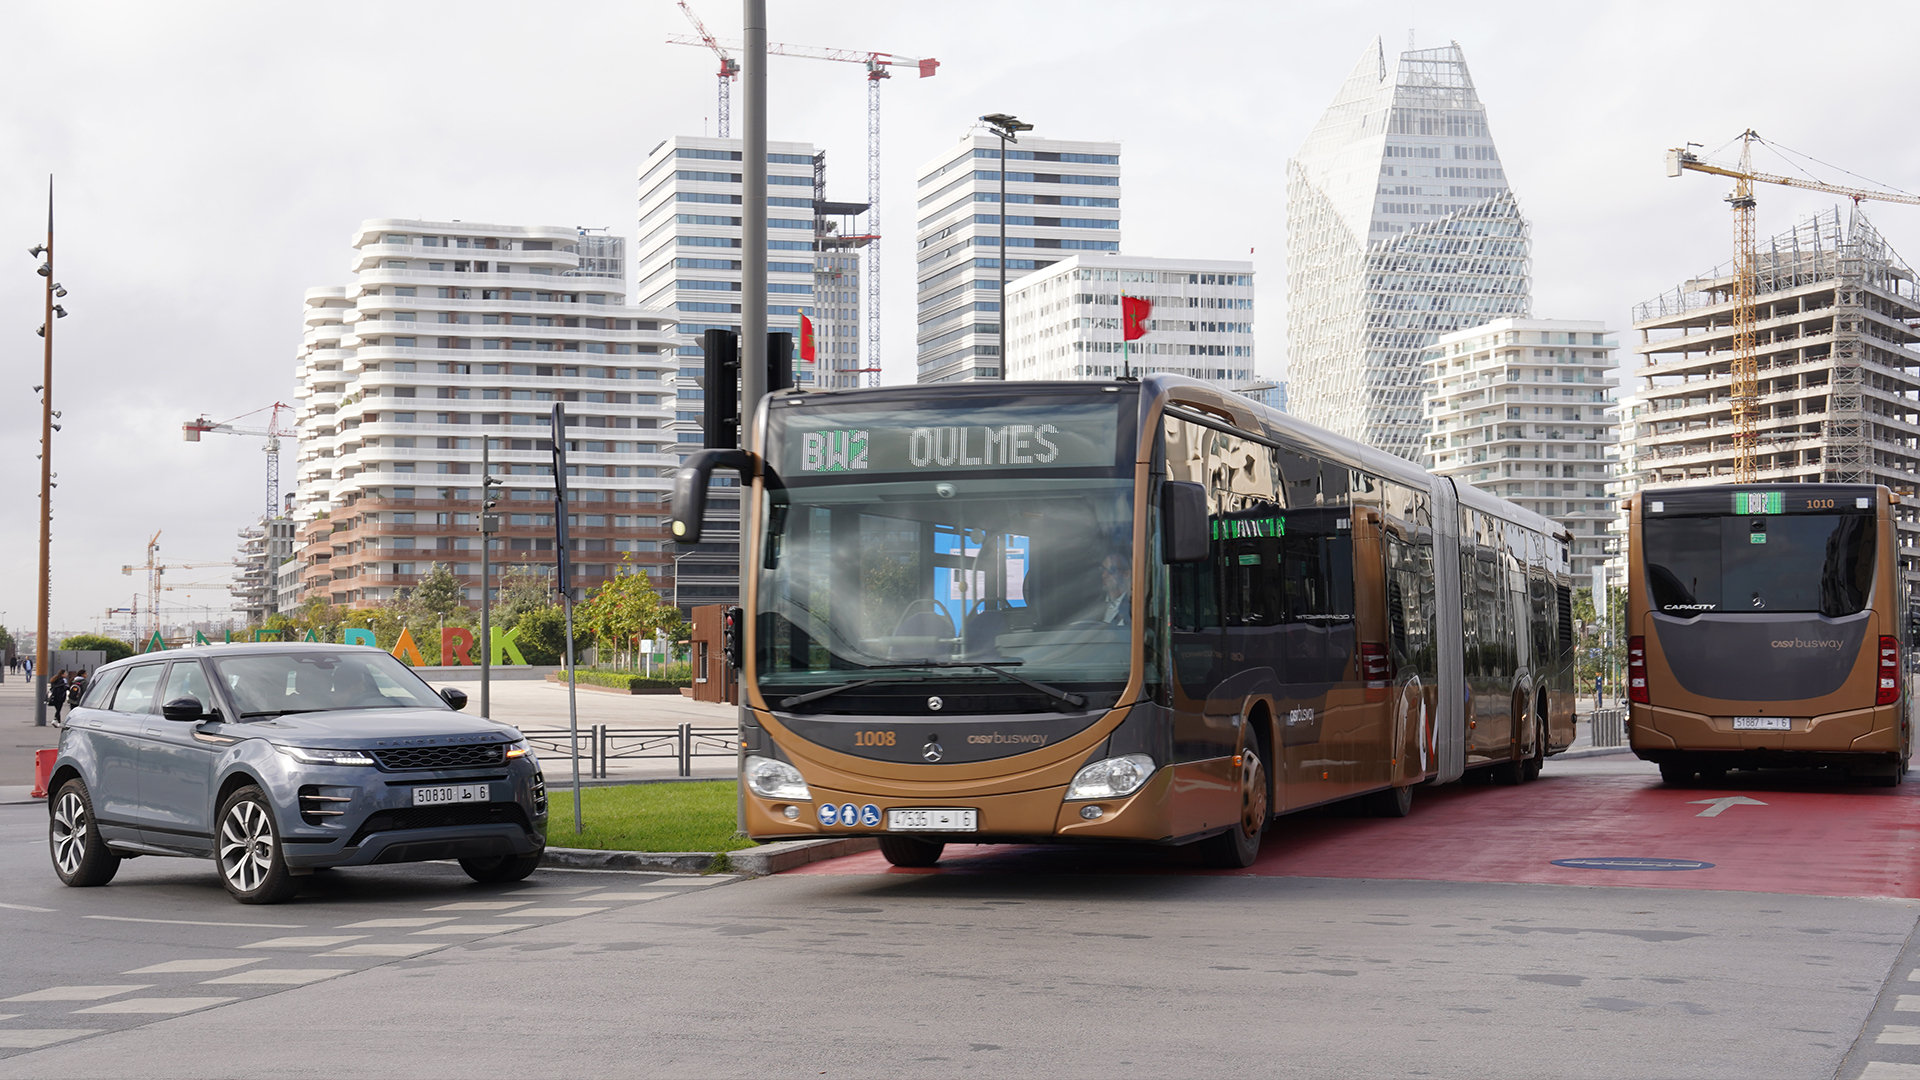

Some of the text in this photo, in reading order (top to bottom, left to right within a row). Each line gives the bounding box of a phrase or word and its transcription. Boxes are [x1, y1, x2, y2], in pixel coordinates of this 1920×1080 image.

[909, 424, 1059, 467] OULMES
[1806, 499, 1834, 509] 1010
[376, 735, 498, 747] RANGE ROVER
[854, 731, 896, 746] 1008
[418, 787, 453, 802] 50830
[480, 786, 486, 799] 6
[894, 811, 928, 827] 47535
[963, 811, 971, 827] 6
